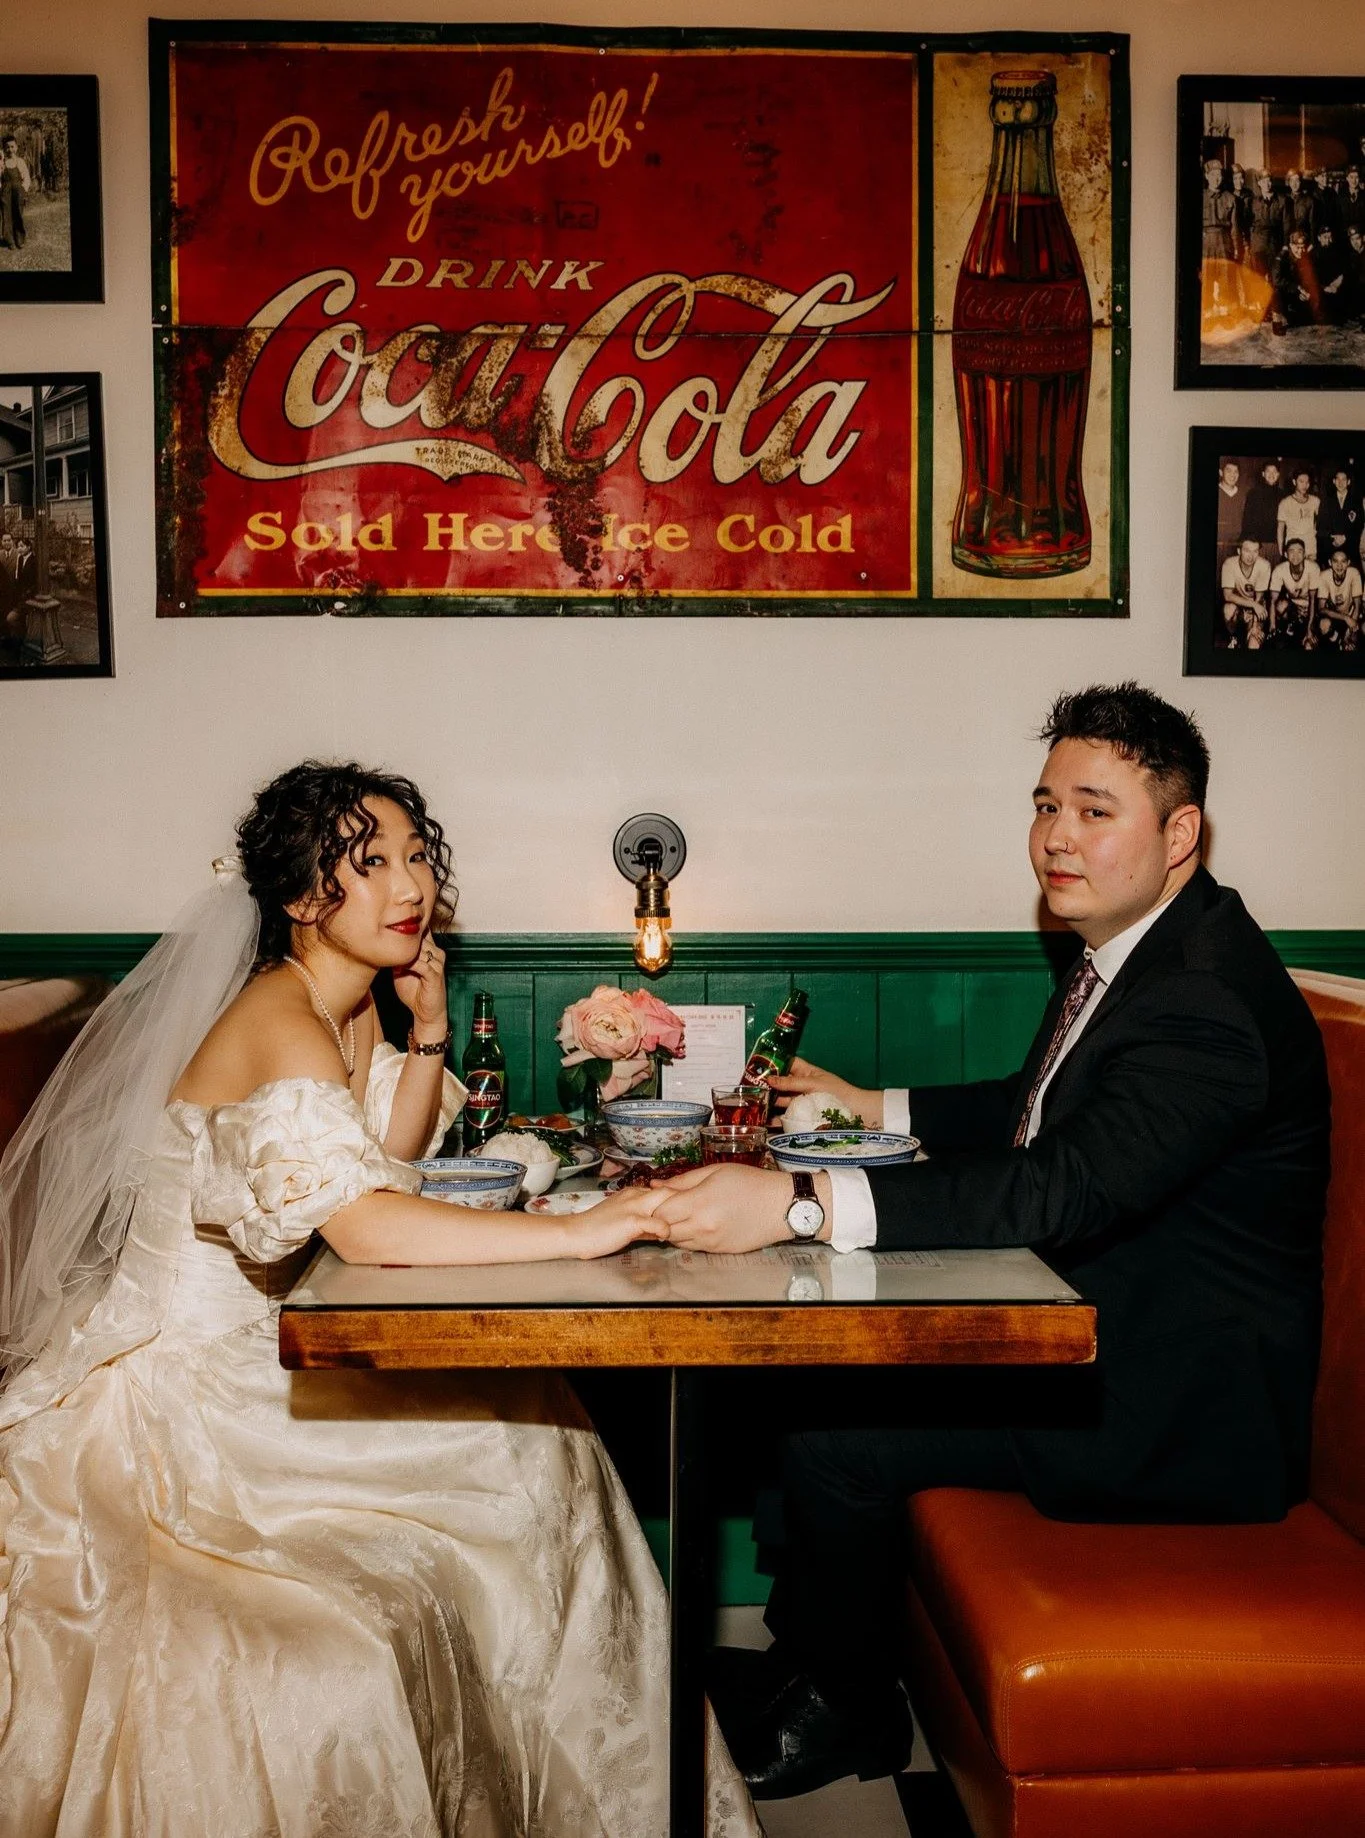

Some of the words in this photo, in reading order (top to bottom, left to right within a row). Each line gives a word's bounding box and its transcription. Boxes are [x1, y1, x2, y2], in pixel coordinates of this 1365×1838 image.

[249, 67, 525, 220] Refresh
[400, 72, 659, 243] yourself!
[376, 257, 606, 292] DRINK
[207, 267, 899, 487] Coca-Cola
[244, 513, 395, 552] Sold
[600, 513, 690, 553] Ice
[715, 513, 854, 553] Cold
